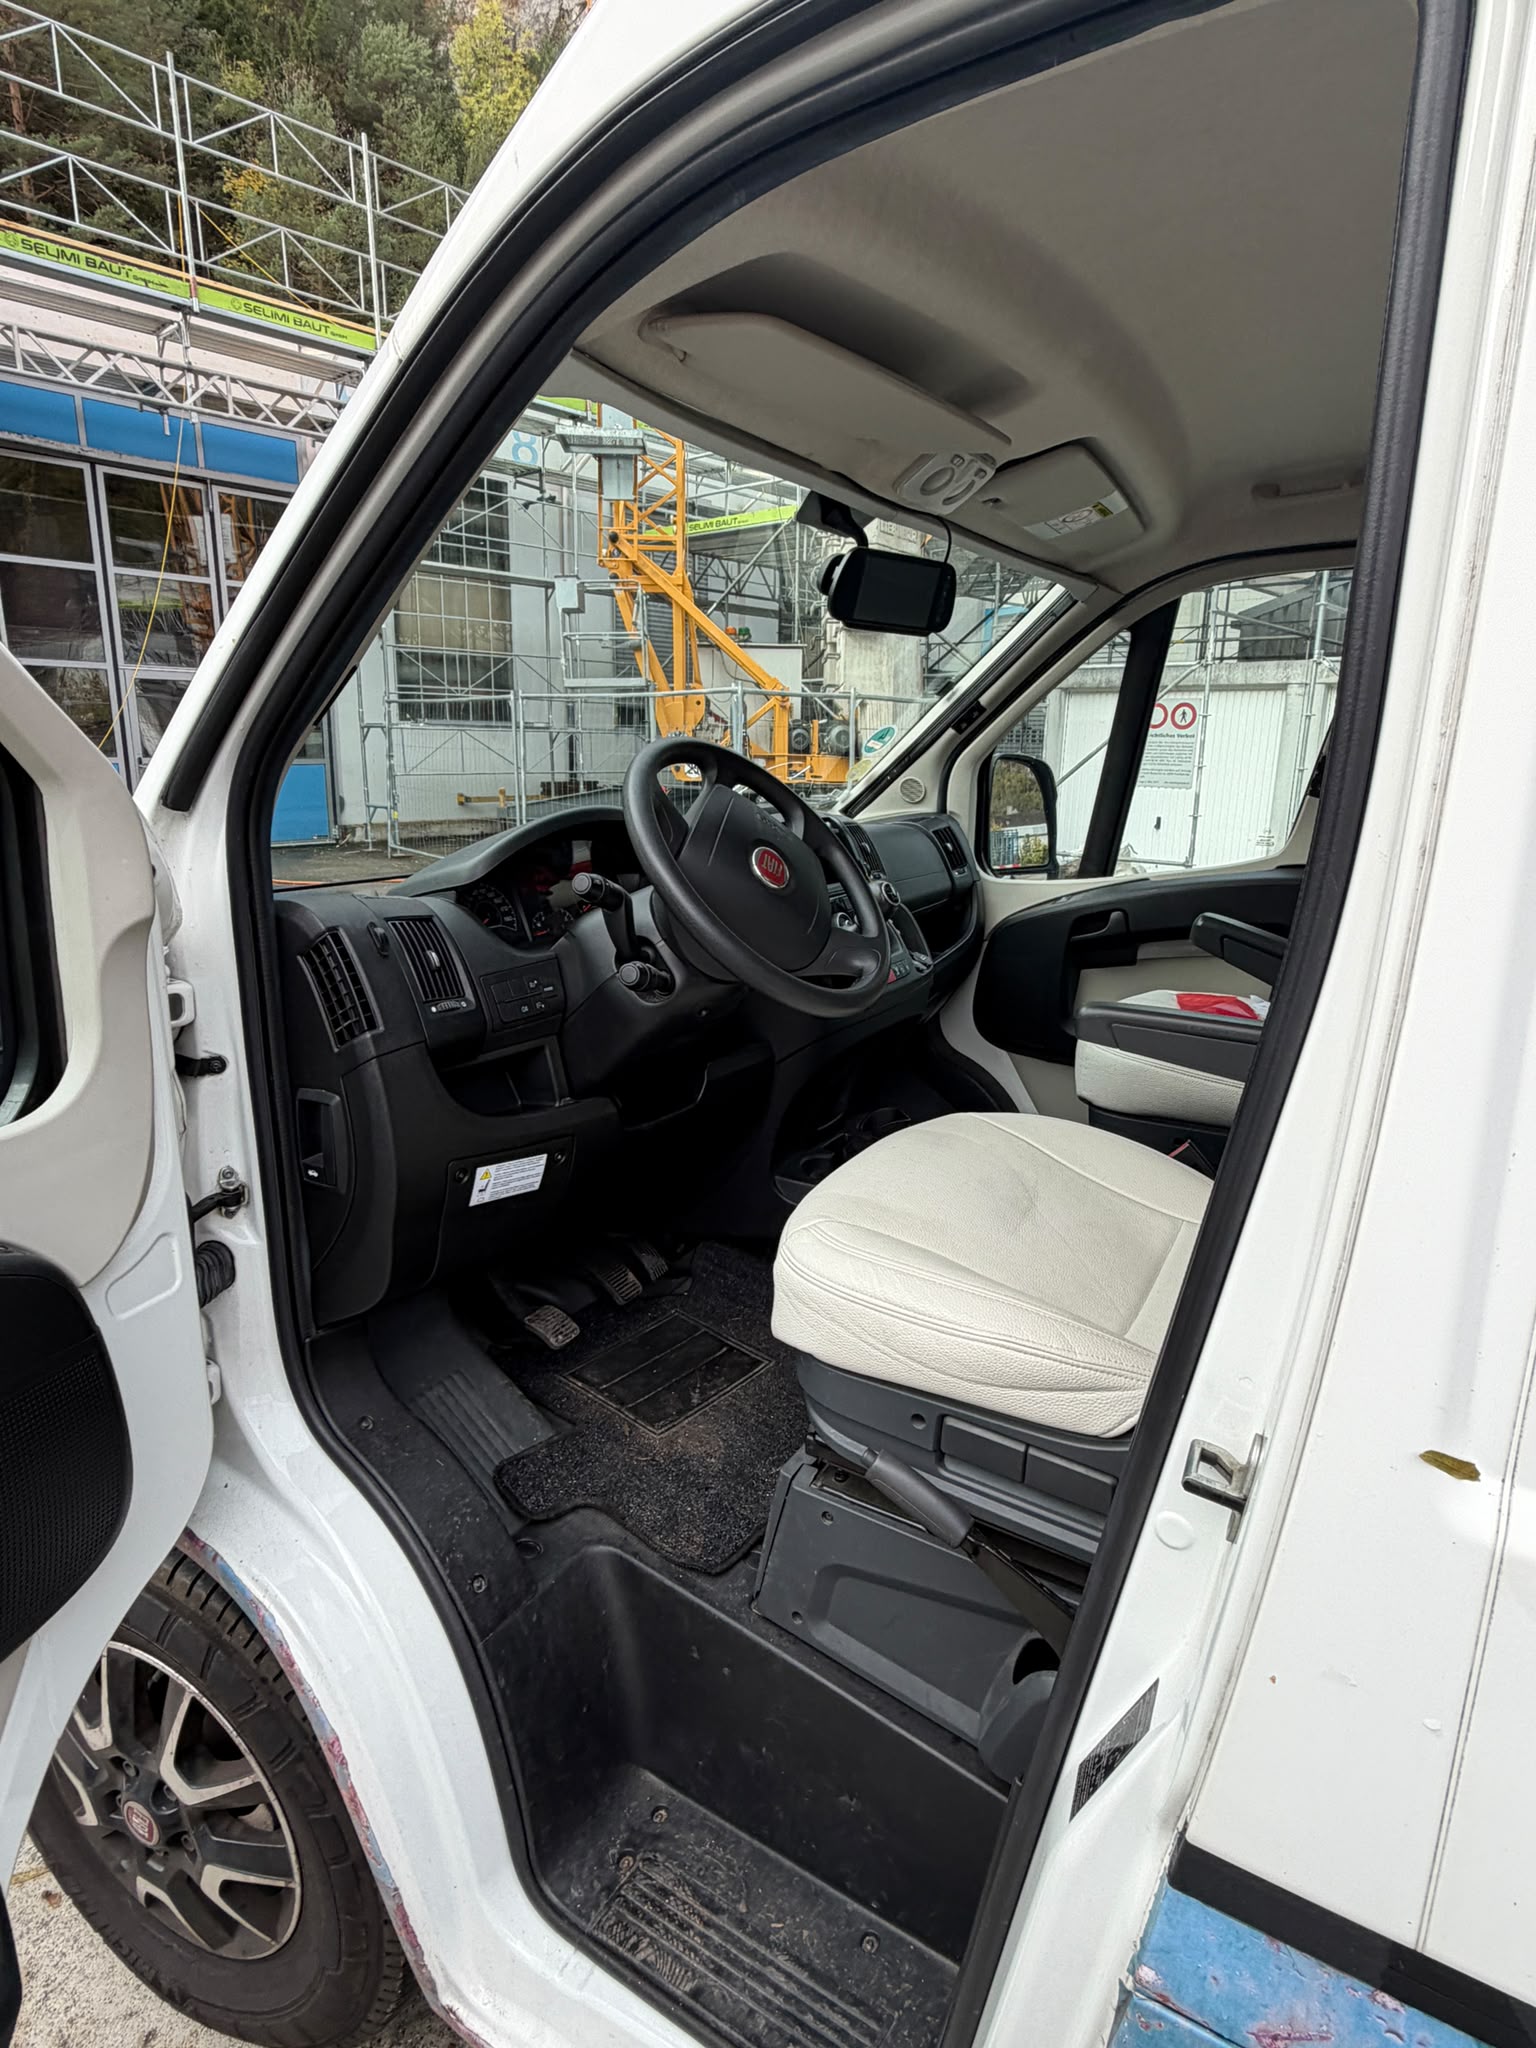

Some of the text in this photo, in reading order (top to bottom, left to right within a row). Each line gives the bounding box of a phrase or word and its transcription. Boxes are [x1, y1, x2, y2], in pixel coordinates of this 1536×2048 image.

[85, 257, 133, 278] BAUT
[243, 302, 290, 323] SELIMI
[293, 317, 330, 335] BAUT
[511, 431, 538, 465] 8
[688, 521, 714, 532] SELIMI
[715, 517, 738, 528] BAUT
[761, 853, 783, 878] FIAT
